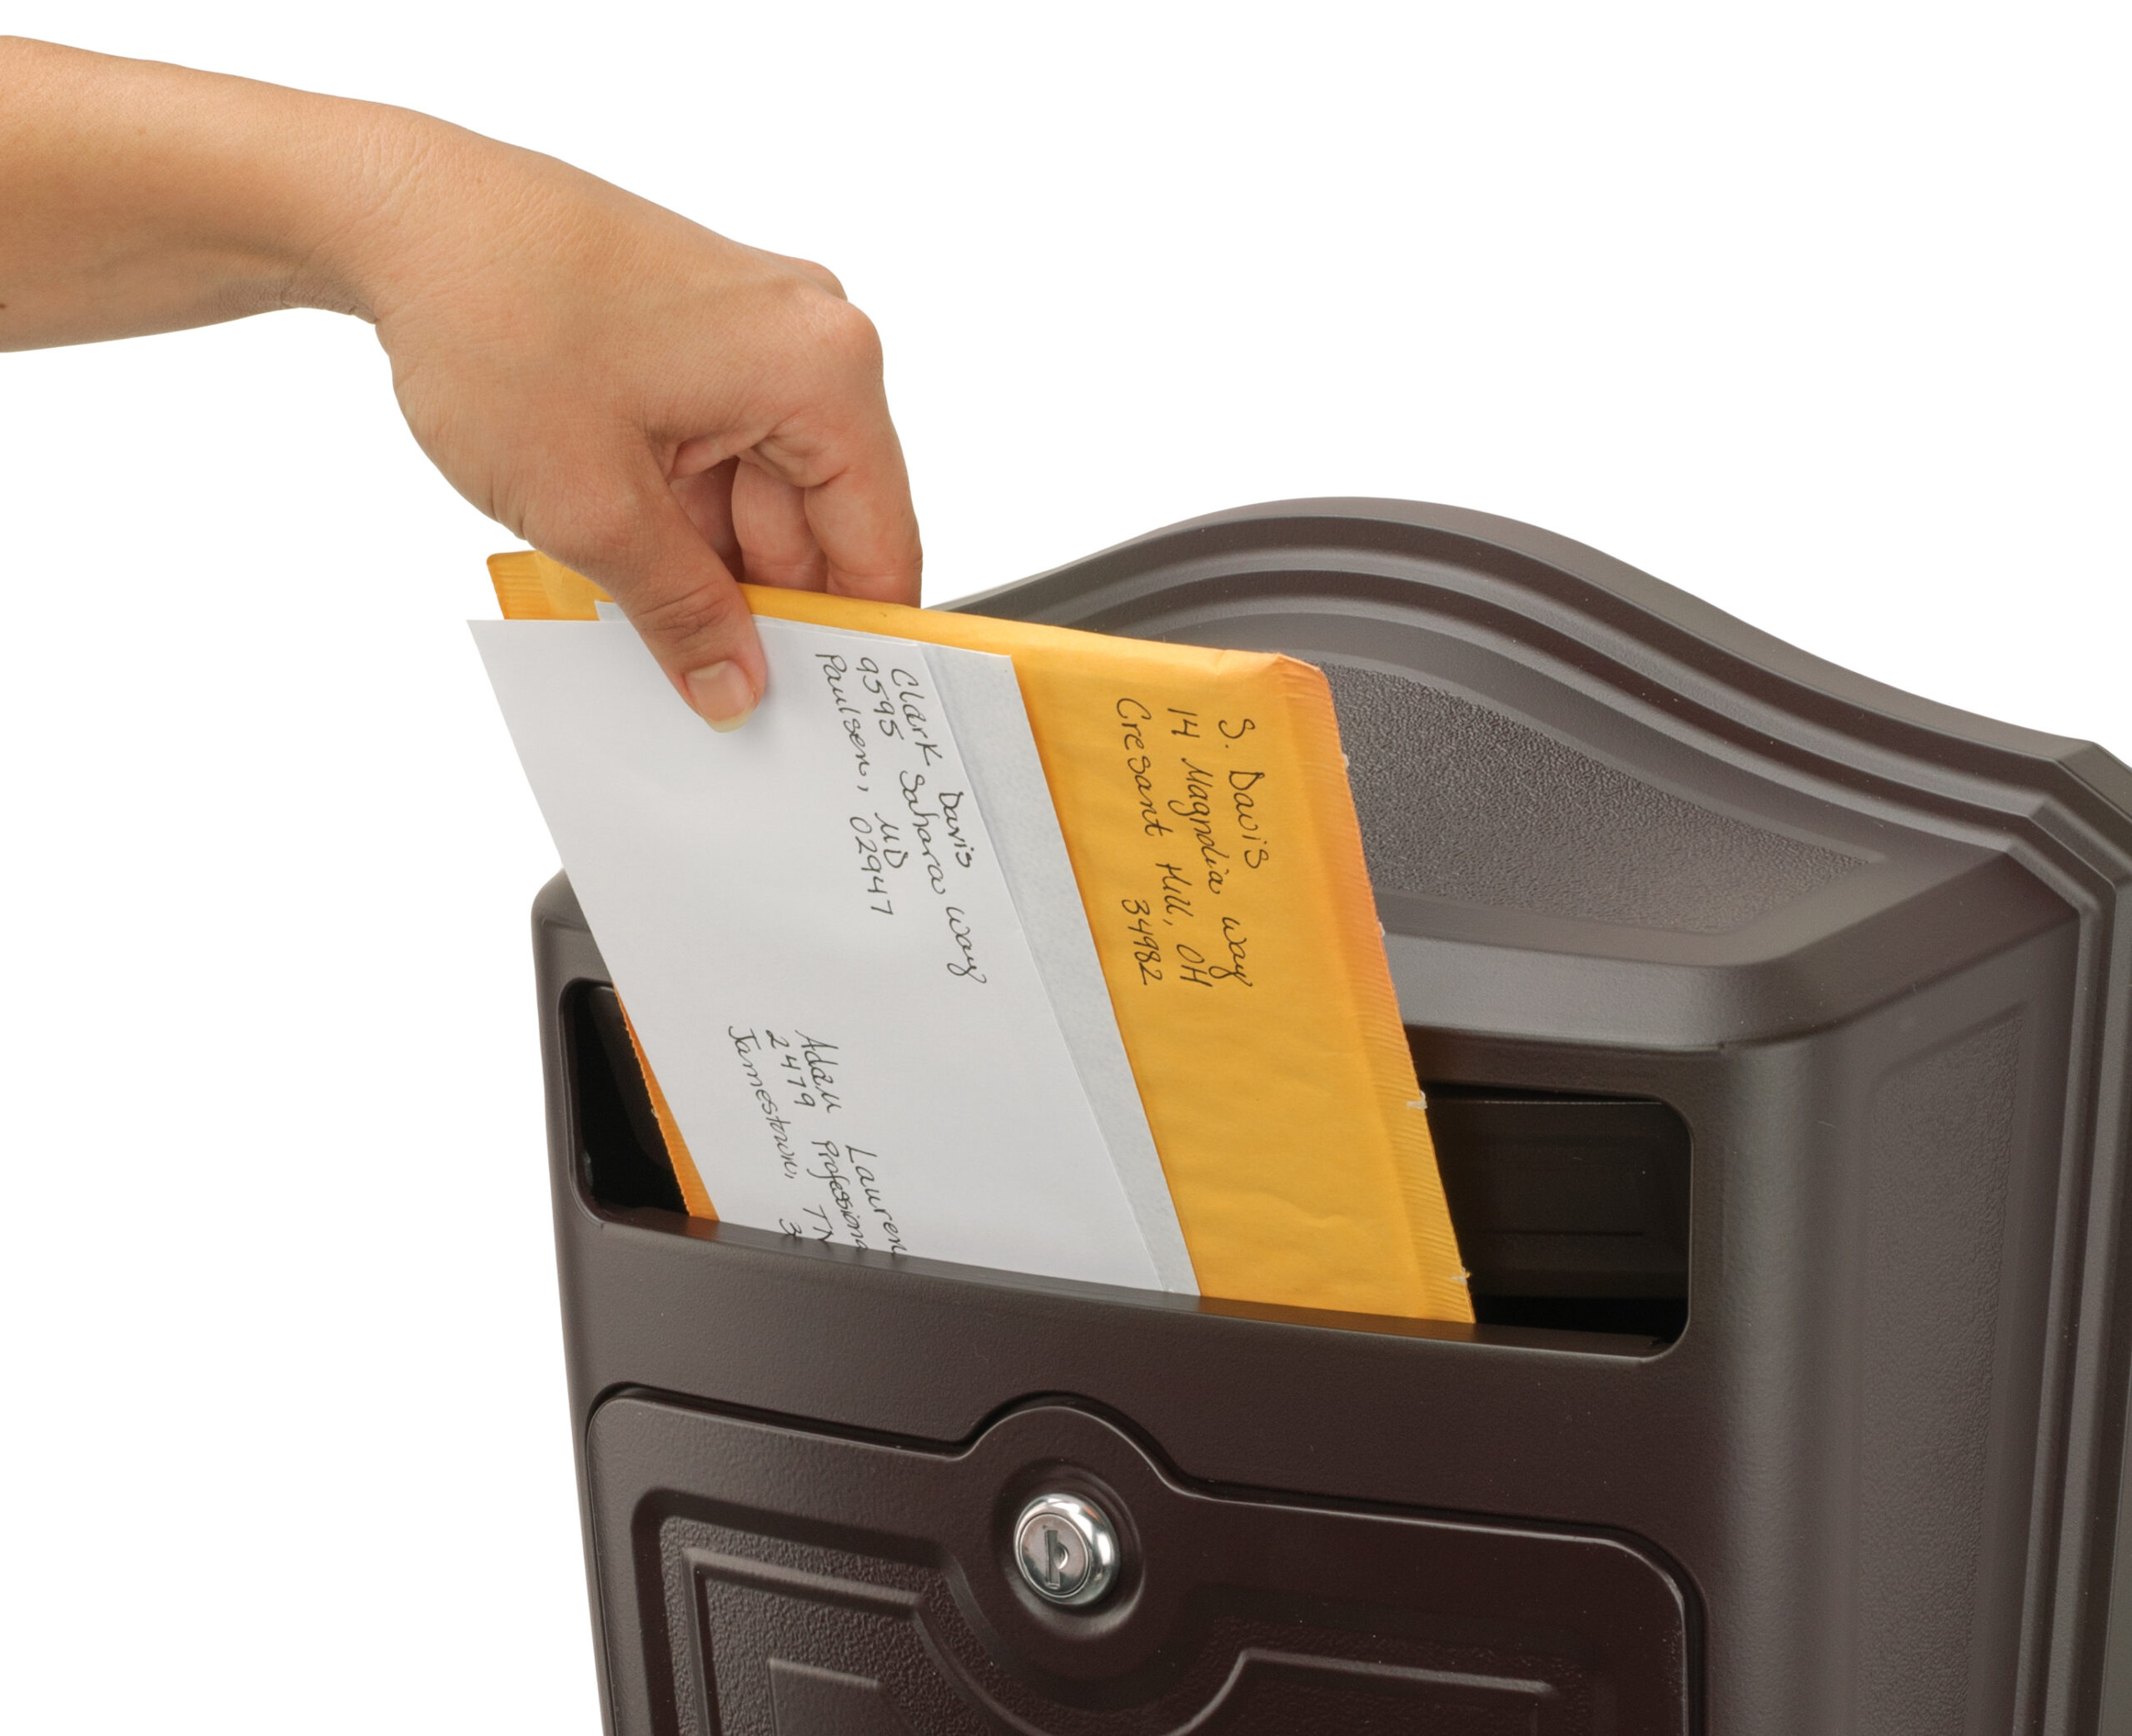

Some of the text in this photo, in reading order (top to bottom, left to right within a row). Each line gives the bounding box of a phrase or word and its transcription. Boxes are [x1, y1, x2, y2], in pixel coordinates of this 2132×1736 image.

[1167, 708, 1200, 739] 14
[856, 657, 904, 741] 9595
[899, 769, 946, 895] Sahara
[1218, 718, 1269, 869] S. Davis
[849, 816, 894, 916] 02947
[874, 812, 909, 869] MD
[939, 791, 972, 868] Davis
[1116, 698, 1213, 988] Cresant Hill, OH
[1167, 757, 1230, 895] Magnolia
[1121, 898, 1163, 986] 34982
[765, 1029, 816, 1107] 2479
